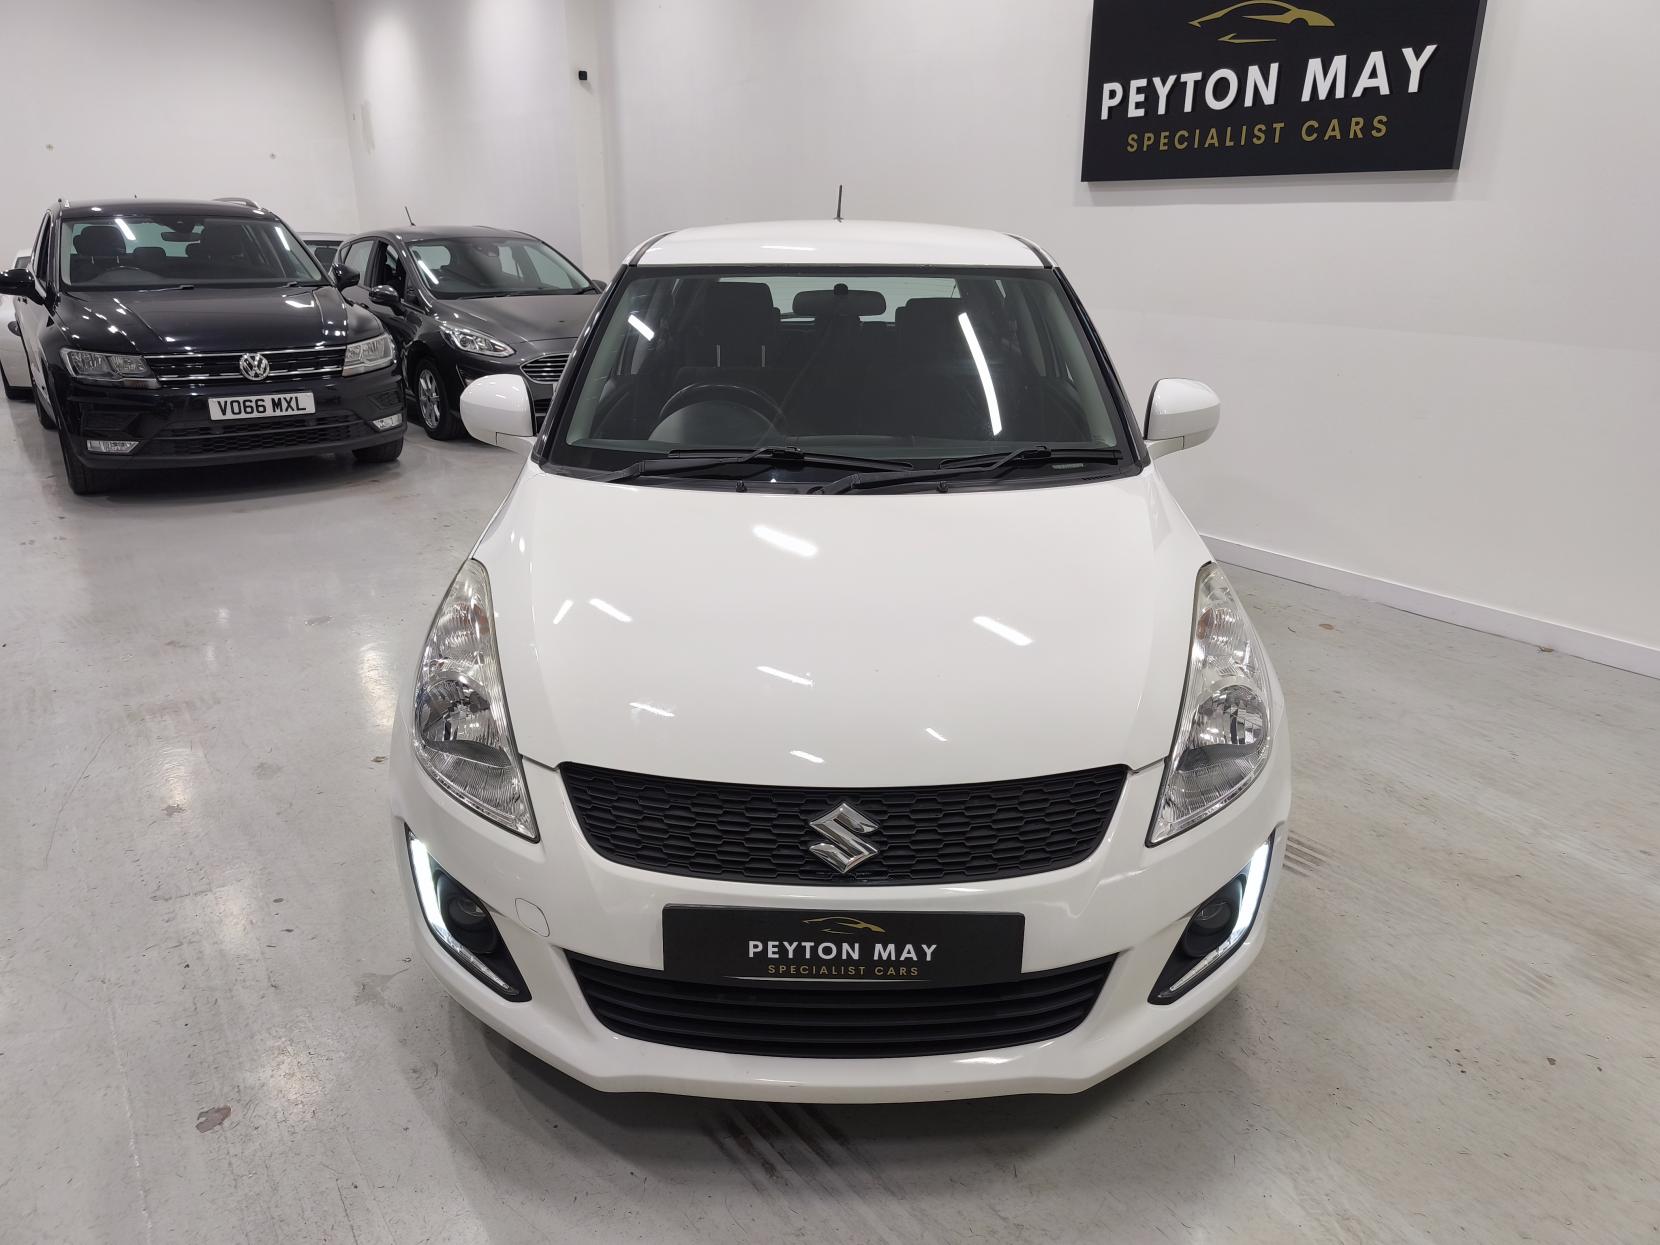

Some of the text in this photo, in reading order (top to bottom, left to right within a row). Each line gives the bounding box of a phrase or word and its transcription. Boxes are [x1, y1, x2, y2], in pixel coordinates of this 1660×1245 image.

[1100, 44, 1438, 120] PEYTON MAY
[1126, 115, 1389, 152] SPECIALIST CARS
[271, 396, 307, 413] MXL
[748, 940, 938, 961] PEYTON MAY
[767, 964, 919, 976] SPECIALIST CARS
